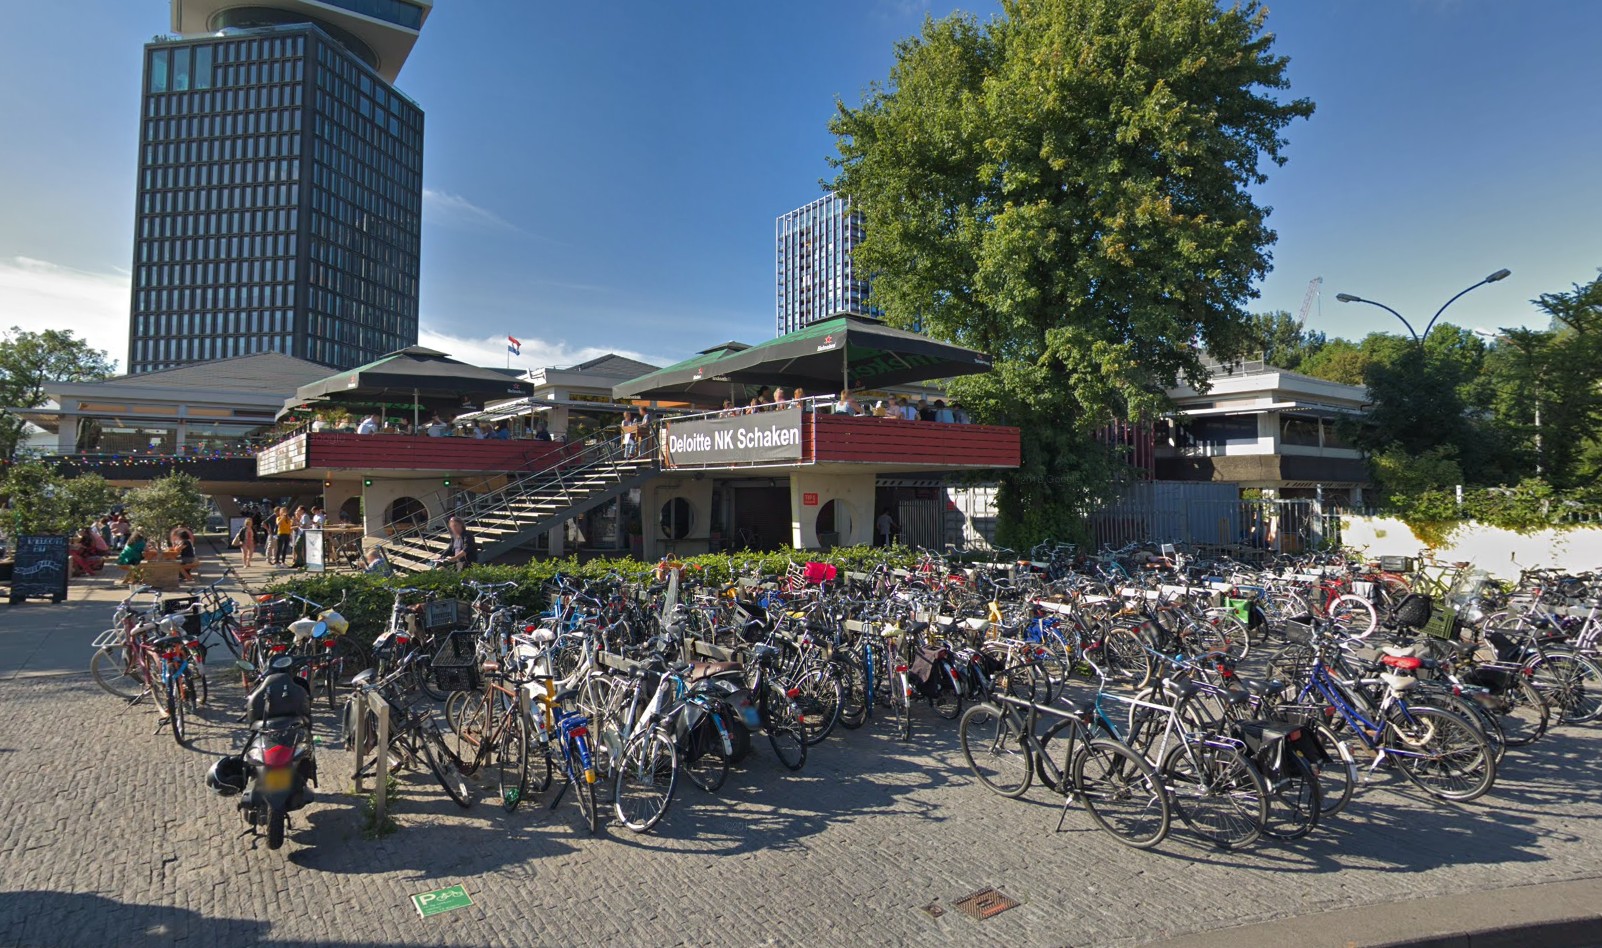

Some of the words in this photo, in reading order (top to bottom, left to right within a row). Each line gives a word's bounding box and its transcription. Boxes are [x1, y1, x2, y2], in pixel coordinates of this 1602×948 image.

[669, 432, 711, 453] Deloitte
[714, 429, 734, 450] NK
[737, 425, 799, 449] Schaken
[419, 893, 436, 906] P
